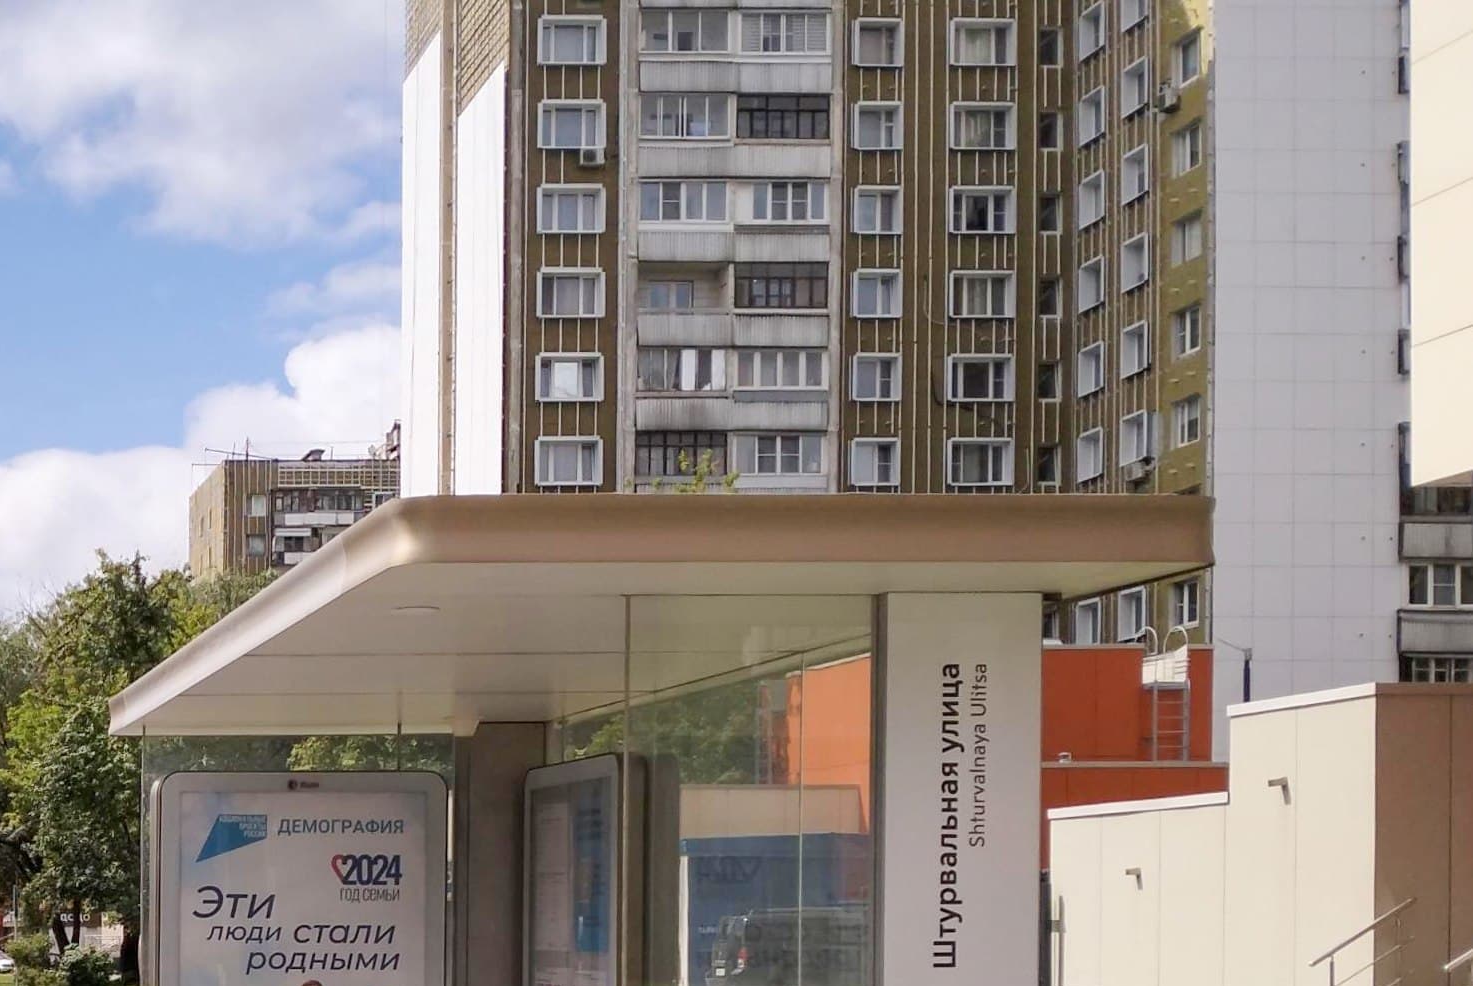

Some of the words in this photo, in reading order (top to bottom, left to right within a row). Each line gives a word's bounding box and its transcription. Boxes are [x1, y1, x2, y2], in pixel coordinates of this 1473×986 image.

[970, 663, 987, 716] Ulitsa
[941, 663, 964, 753] улица
[969, 723, 989, 847] Shturvalnaya
[277, 819, 404, 836] ДЕМОГРАФИЯ
[342, 854, 402, 885] 2024
[933, 762, 962, 968] Штурвальная
[192, 885, 276, 919] Эти
[340, 887, 360, 903] ГОД
[207, 925, 281, 944] люди
[293, 924, 396, 944] стали
[245, 952, 400, 975] родными
